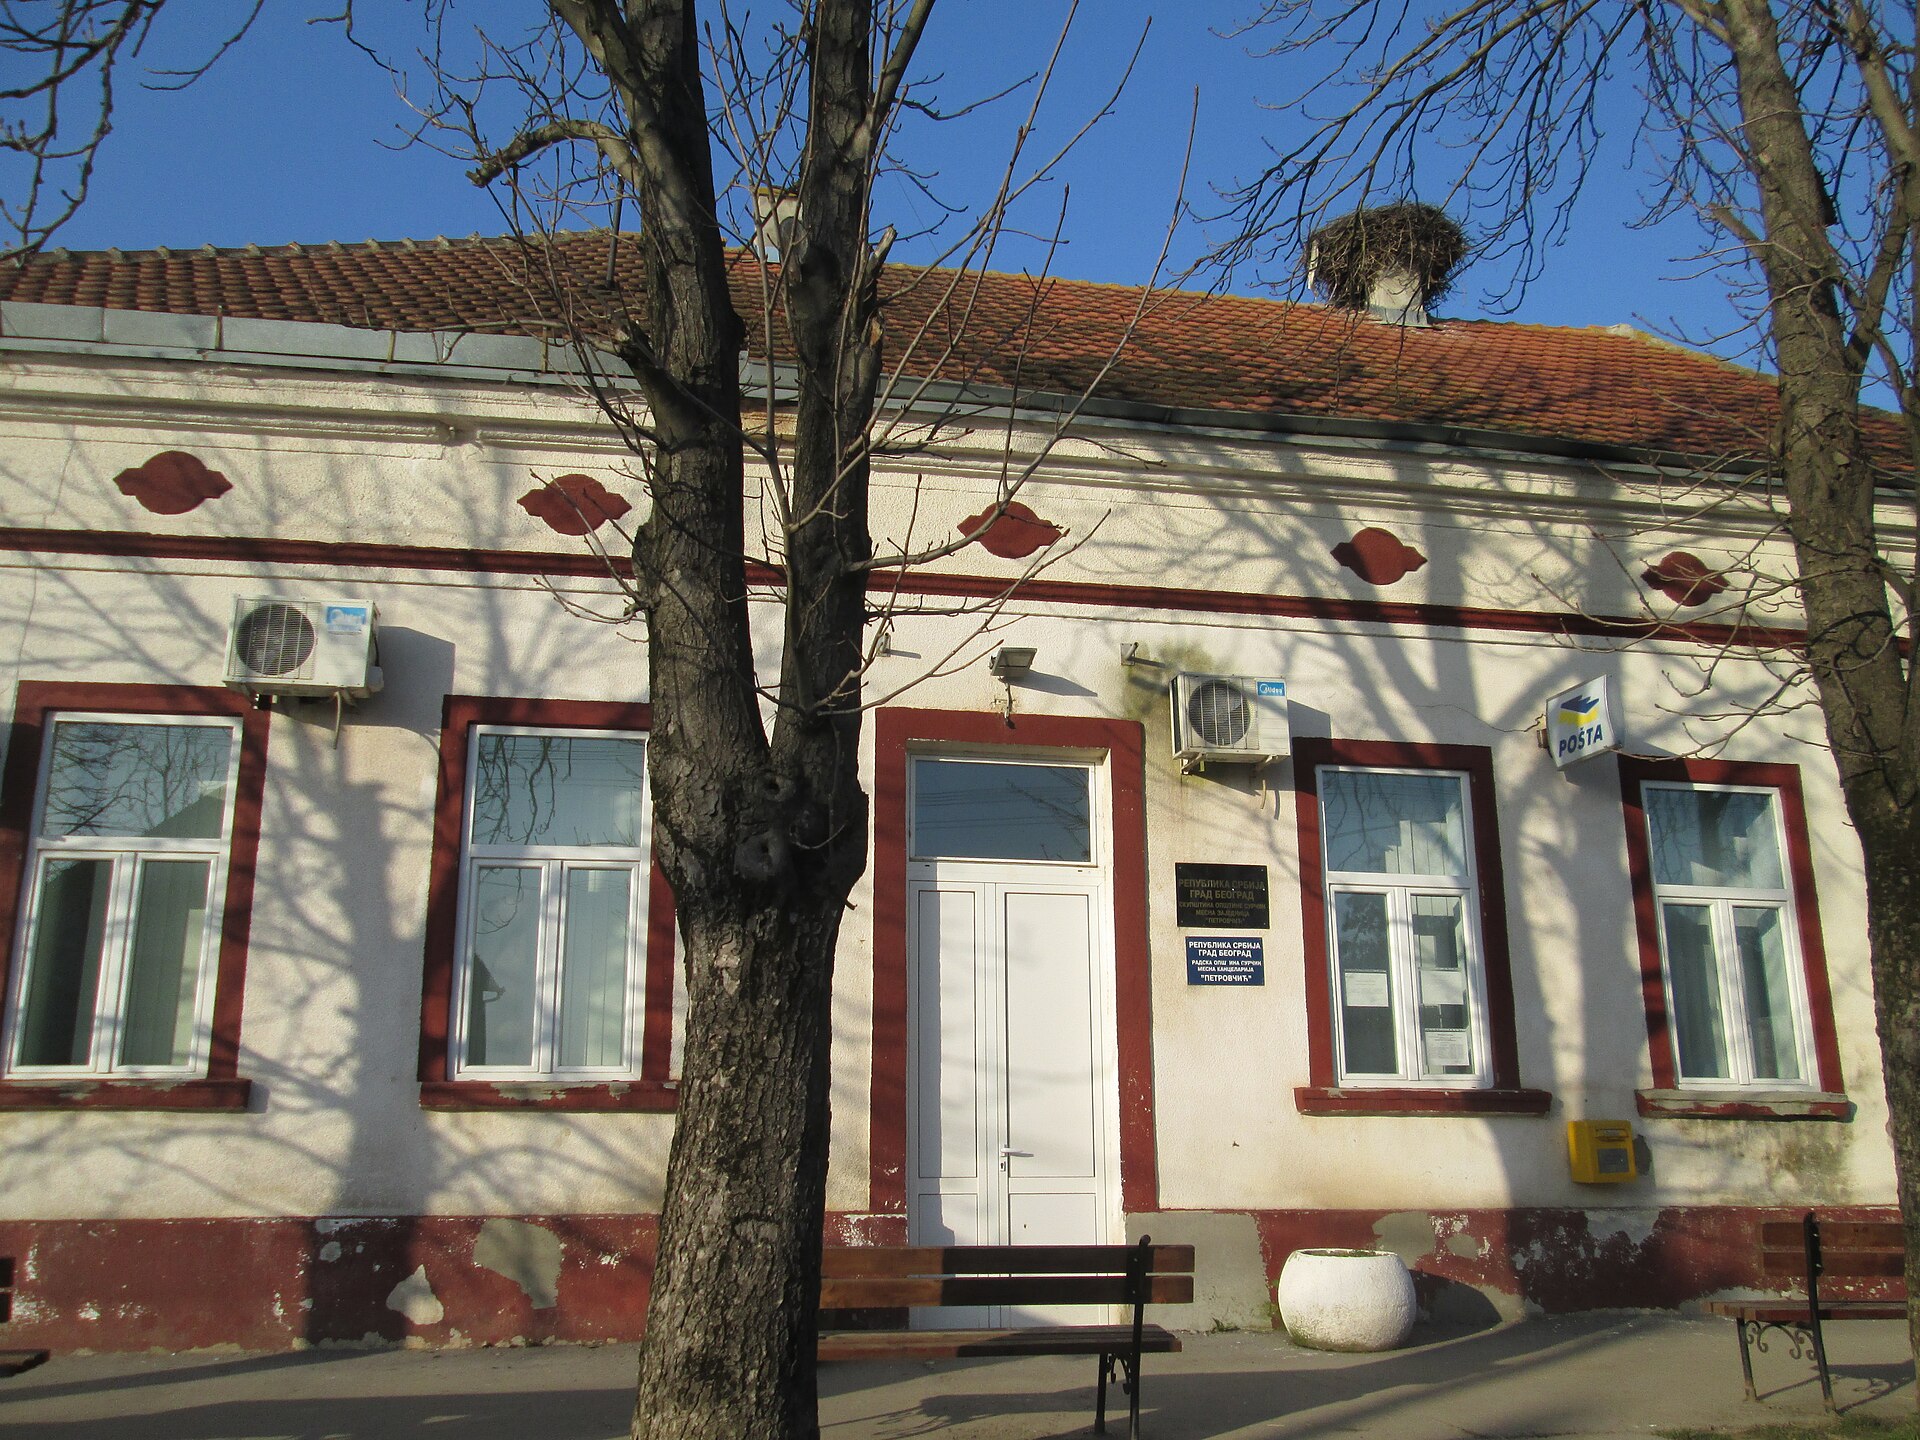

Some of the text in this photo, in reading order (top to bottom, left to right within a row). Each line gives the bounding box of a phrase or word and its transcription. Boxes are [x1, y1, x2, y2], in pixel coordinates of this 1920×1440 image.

[1558, 724, 1603, 758] POŠTA
[1178, 879, 1265, 889] РЕПУБЛИКА СРБИЈА
[1189, 889, 1255, 901] ГРАД БЕОГРАД
[1188, 941, 1231, 949] РЕПУБЛИКА
[1198, 949, 1252, 958] ГРАД БЕОГРАД
[1200, 974, 1252, 982] "ПЕТРОВЧИЋ"
